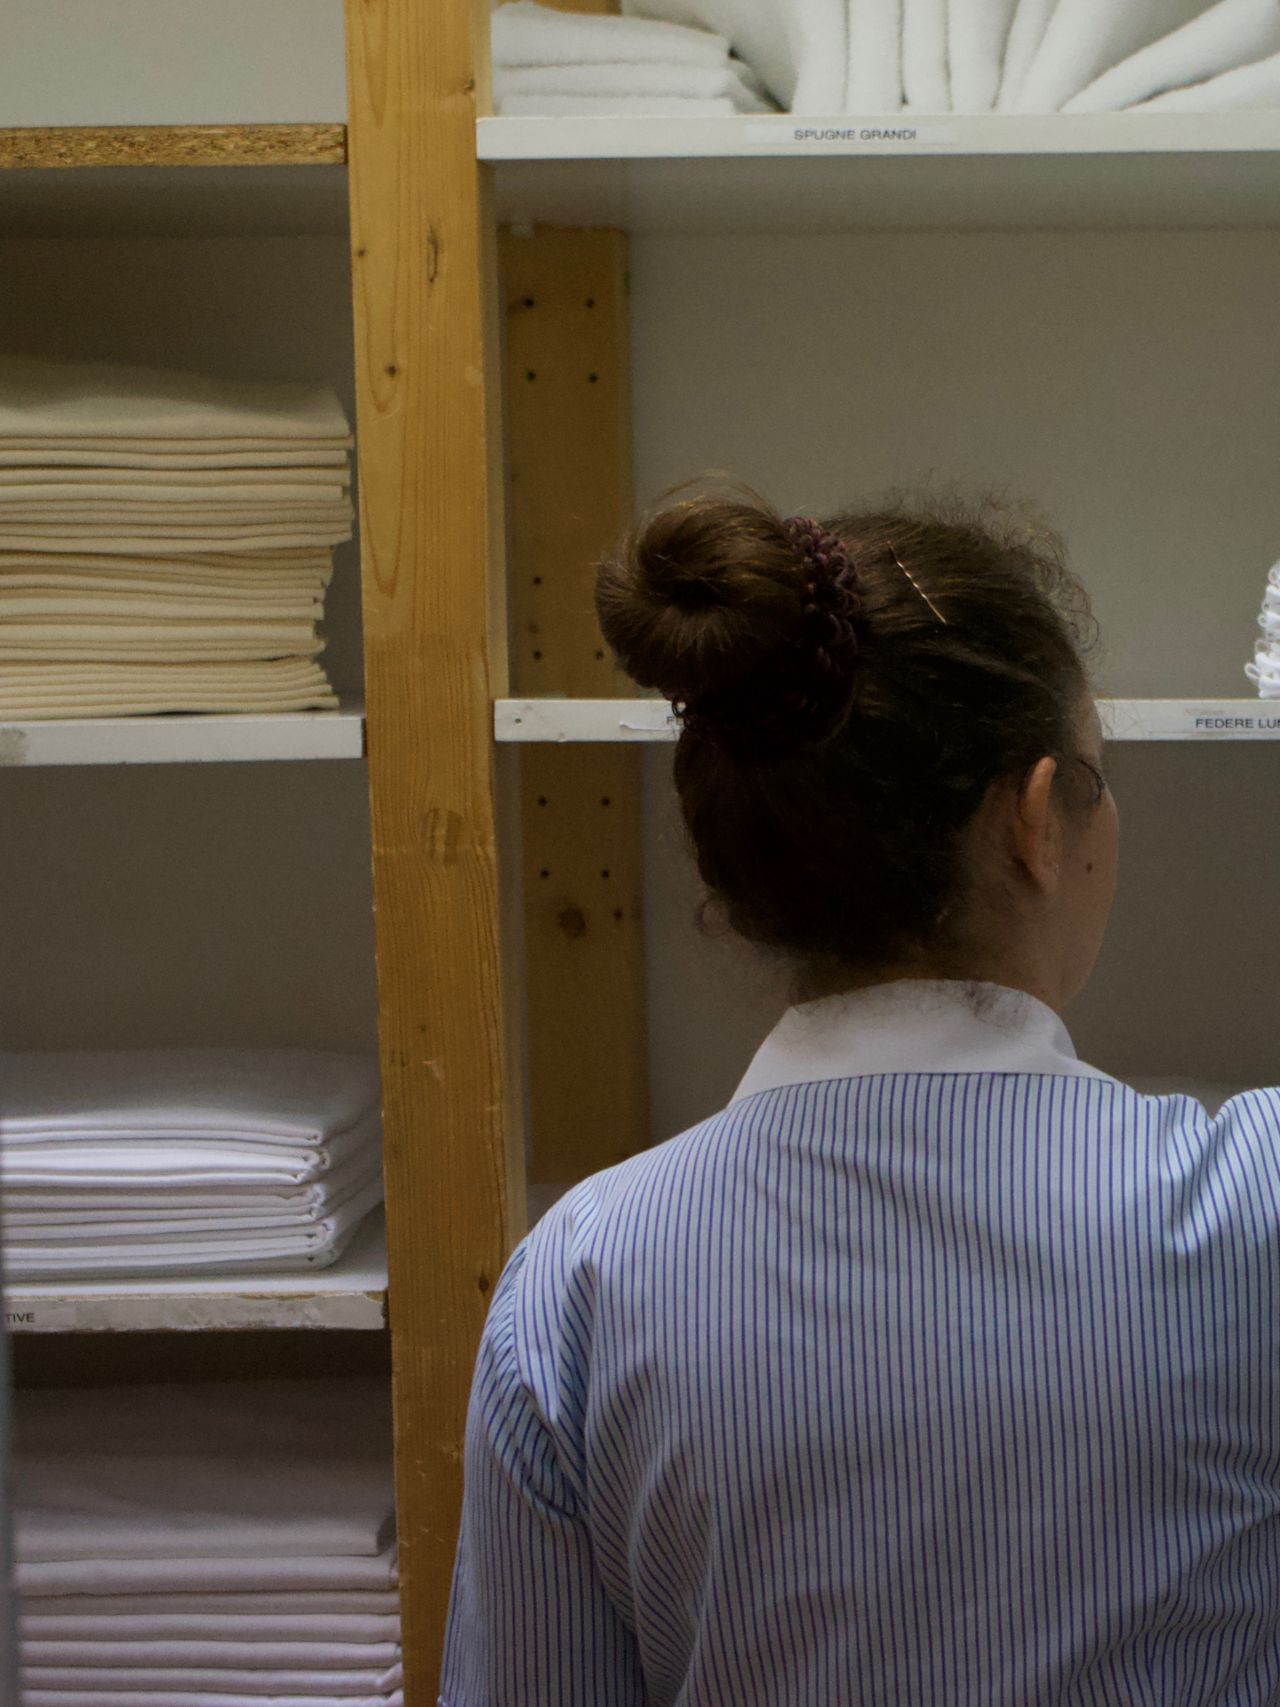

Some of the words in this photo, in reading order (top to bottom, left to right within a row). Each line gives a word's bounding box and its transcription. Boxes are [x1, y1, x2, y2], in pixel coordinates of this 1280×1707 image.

[794, 129, 855, 141] SPUGNE
[859, 129, 917, 140] GRANDI
[1195, 718, 1254, 729] FEDERE
